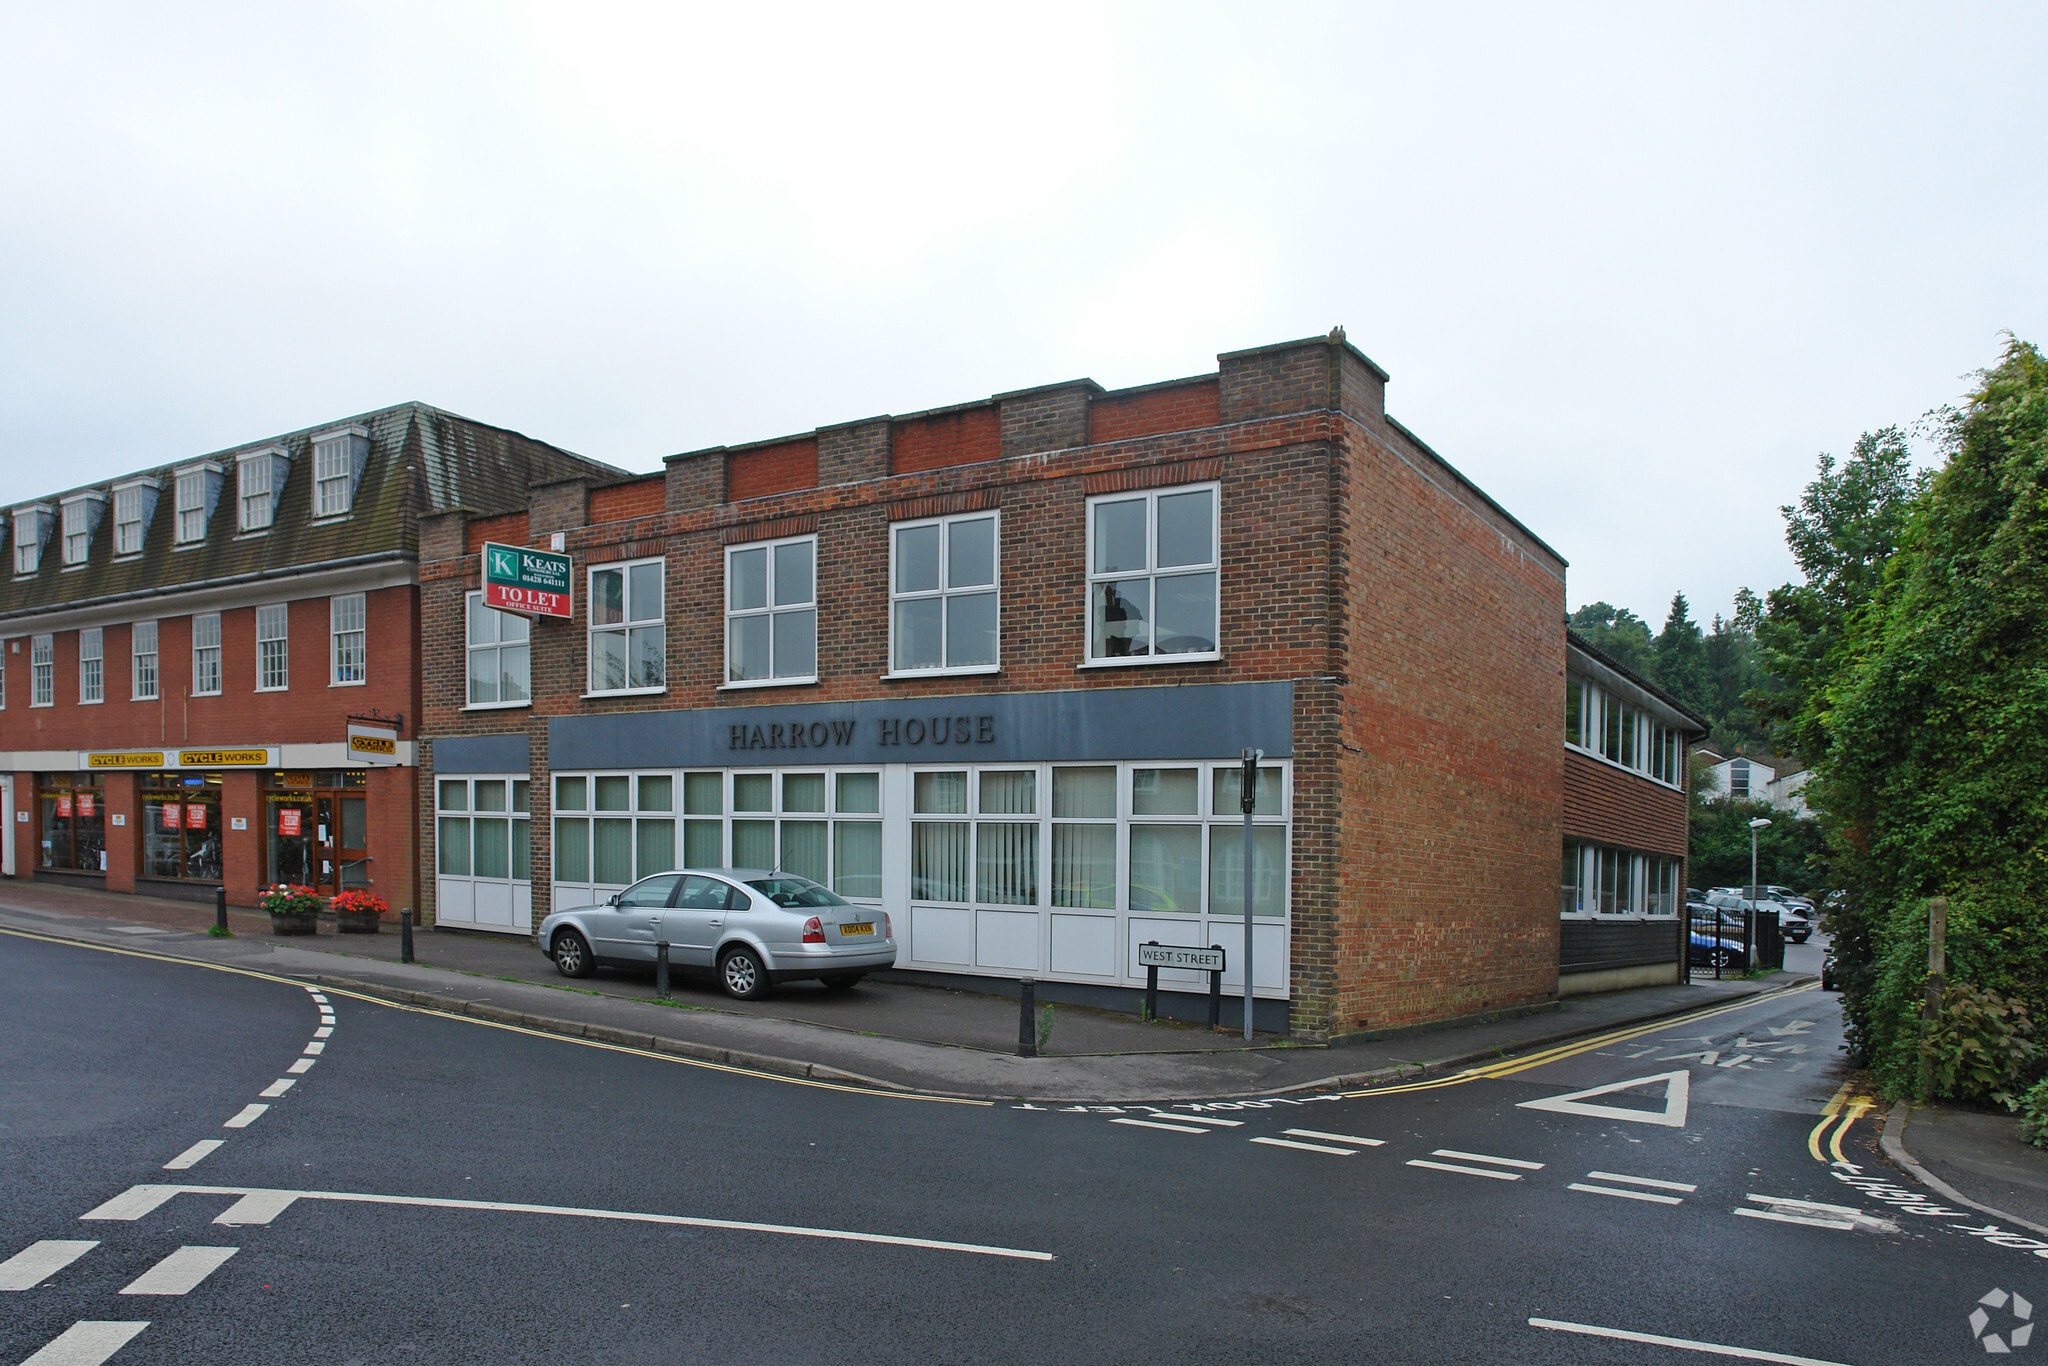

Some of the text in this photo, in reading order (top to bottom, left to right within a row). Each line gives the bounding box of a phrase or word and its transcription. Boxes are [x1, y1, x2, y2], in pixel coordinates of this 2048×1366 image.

[492, 551, 514, 577] K
[522, 554, 566, 573] KEATS
[522, 574, 542, 584] 01428
[498, 585, 560, 608] TO LET
[505, 600, 553, 614] OFFICE SUITE
[728, 714, 995, 750] HARROW HOUSE
[353, 737, 394, 750] CYCLE
[355, 744, 392, 753] WORKS
[91, 755, 160, 766] CYCLE WORKS
[183, 752, 262, 764] CYCLE WORKS
[1143, 950, 1219, 965] WEST STREET
